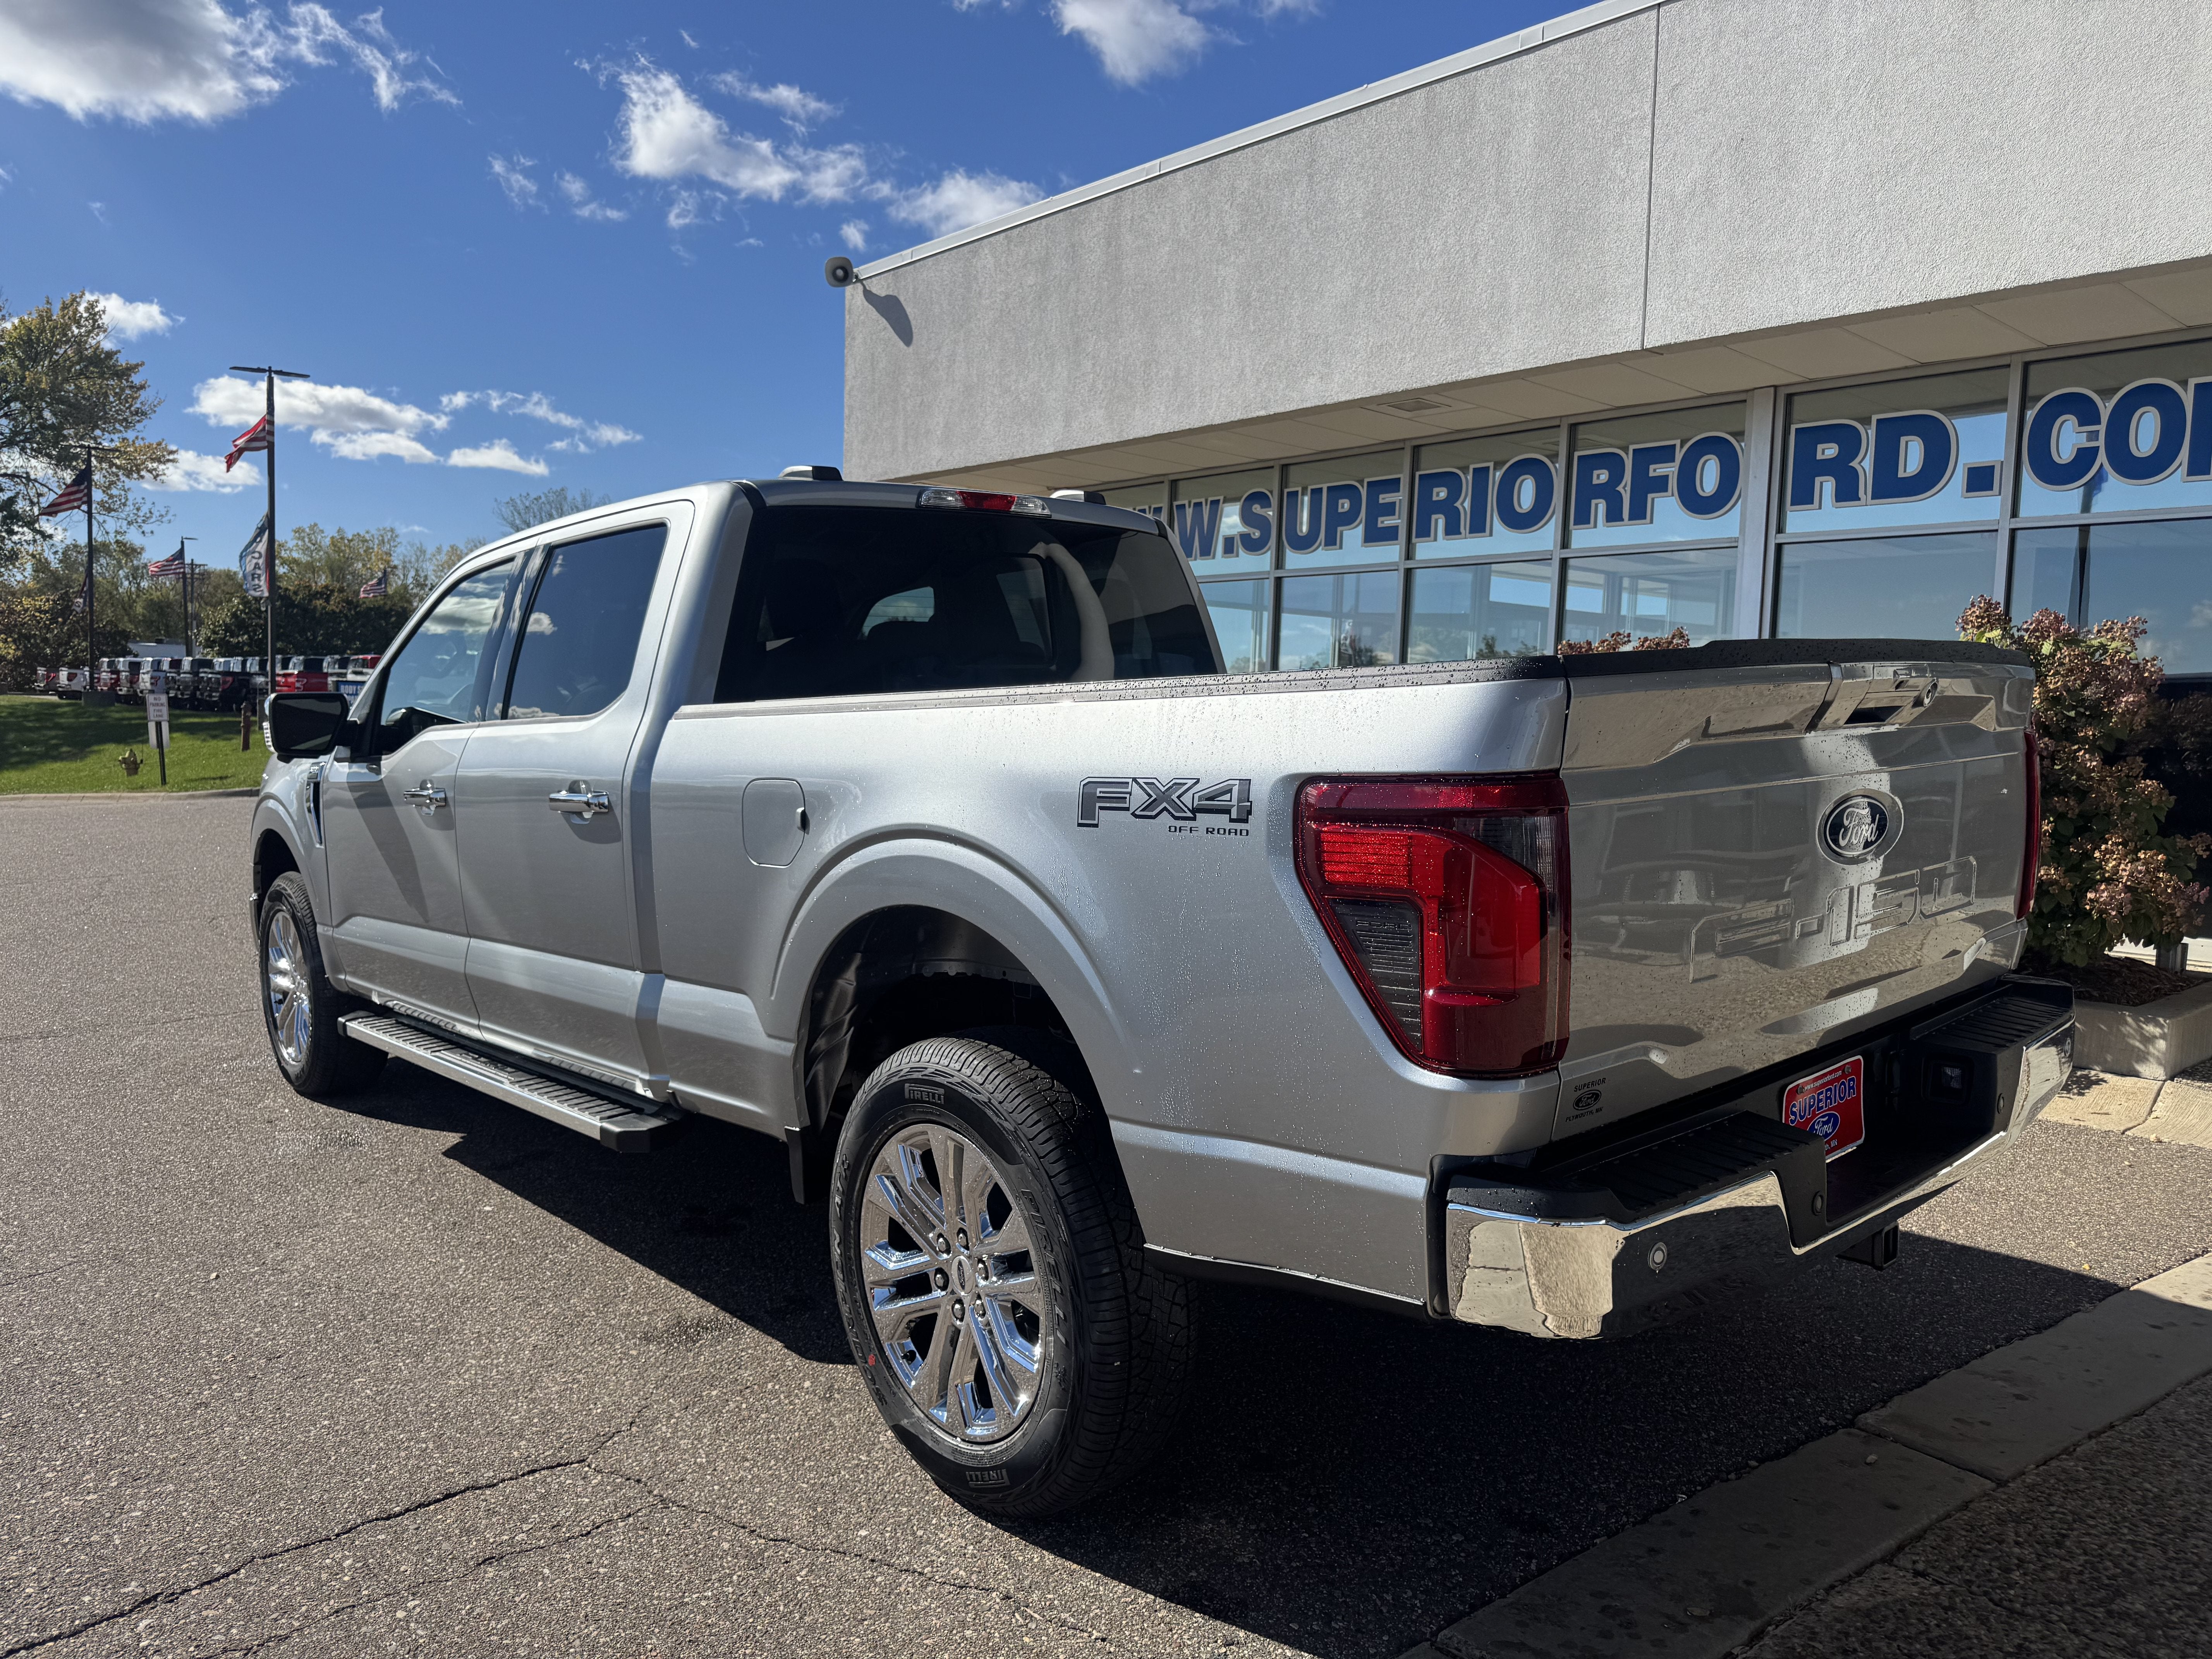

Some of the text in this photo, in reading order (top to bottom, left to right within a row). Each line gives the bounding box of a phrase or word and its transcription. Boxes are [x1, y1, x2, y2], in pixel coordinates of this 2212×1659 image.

[340, 685, 357, 694] BODY
[1077, 776, 1253, 828] FX4
[1168, 825, 1249, 836] OFF ROAD
[1839, 807, 1879, 847] Ford
[1356, 920, 1413, 931] FORD
[1689, 855, 1977, 984] F-150
[904, 1083, 945, 1104] PIRELLI
[1574, 1077, 1606, 1092] SUPERIOR
[1579, 1094, 1596, 1106] Ford
[1789, 1076, 1856, 1126] SUPERIOR
[1814, 1116, 1834, 1136] Ford
[1021, 1189, 1066, 1346] PIRELLI
[965, 1468, 1011, 1488] PIRELLI
